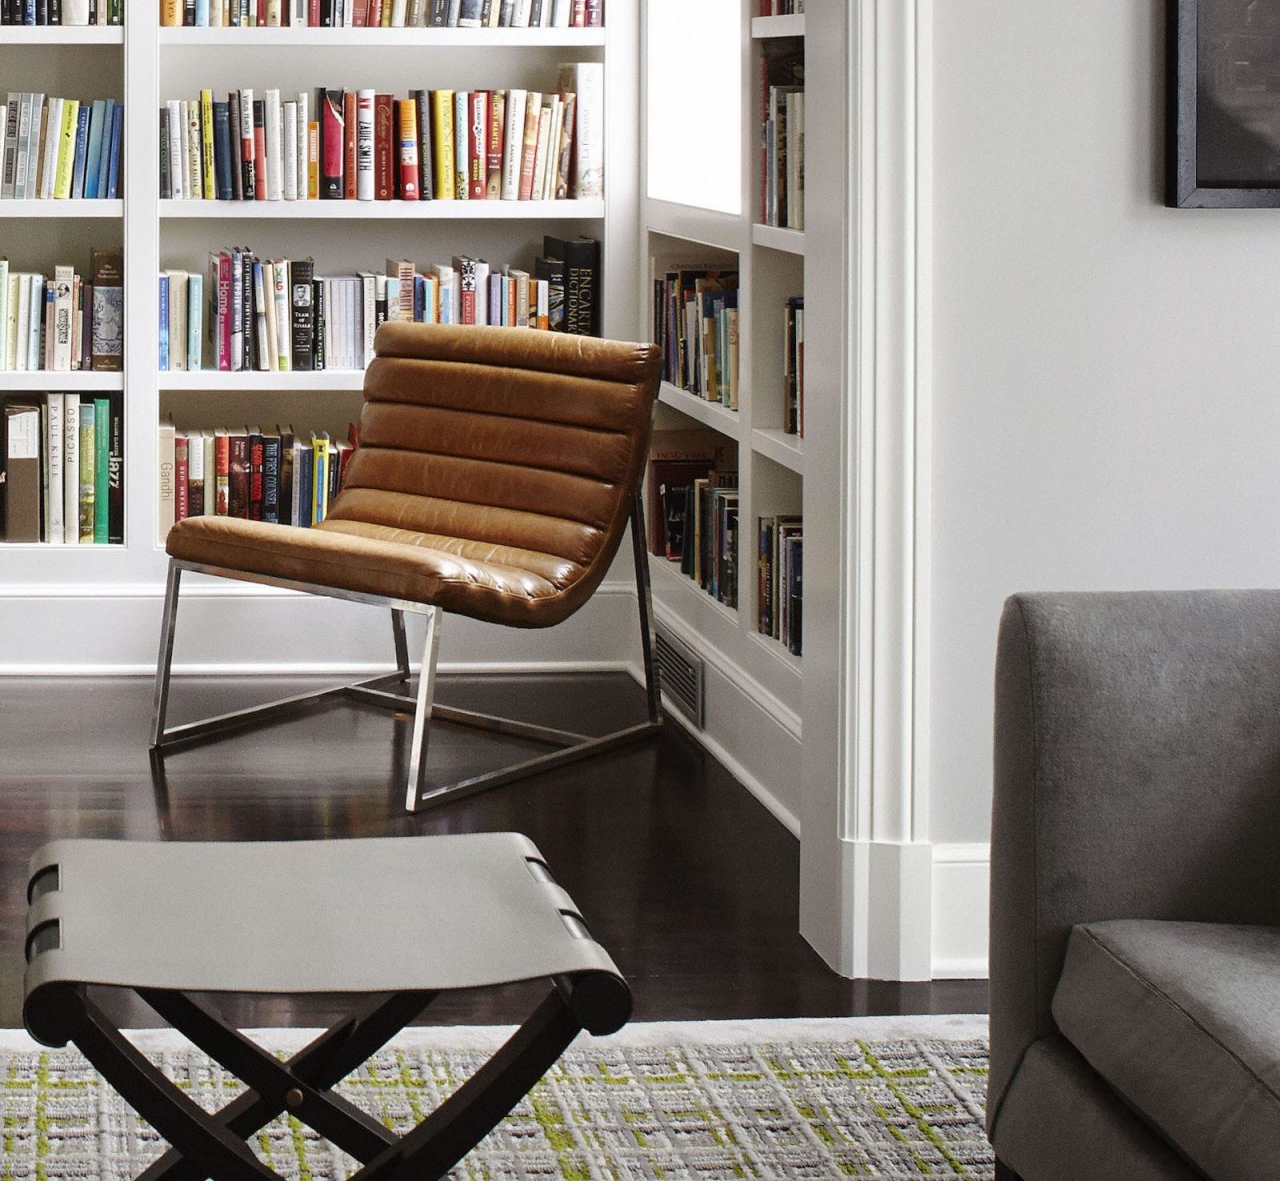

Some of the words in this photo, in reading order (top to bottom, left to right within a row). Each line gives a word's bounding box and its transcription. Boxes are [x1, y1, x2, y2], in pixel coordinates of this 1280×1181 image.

[359, 97, 369, 110] NW
[359, 121, 370, 141] ZADIE
[359, 144, 372, 171] SMITH
[219, 280, 230, 315] Home
[568, 268, 579, 335] DICTIONARY
[578, 268, 592, 337] ENCARTA
[51, 406, 59, 439] PAUL
[51, 446, 59, 480] KLEE
[159, 461, 173, 501] Gandhi
